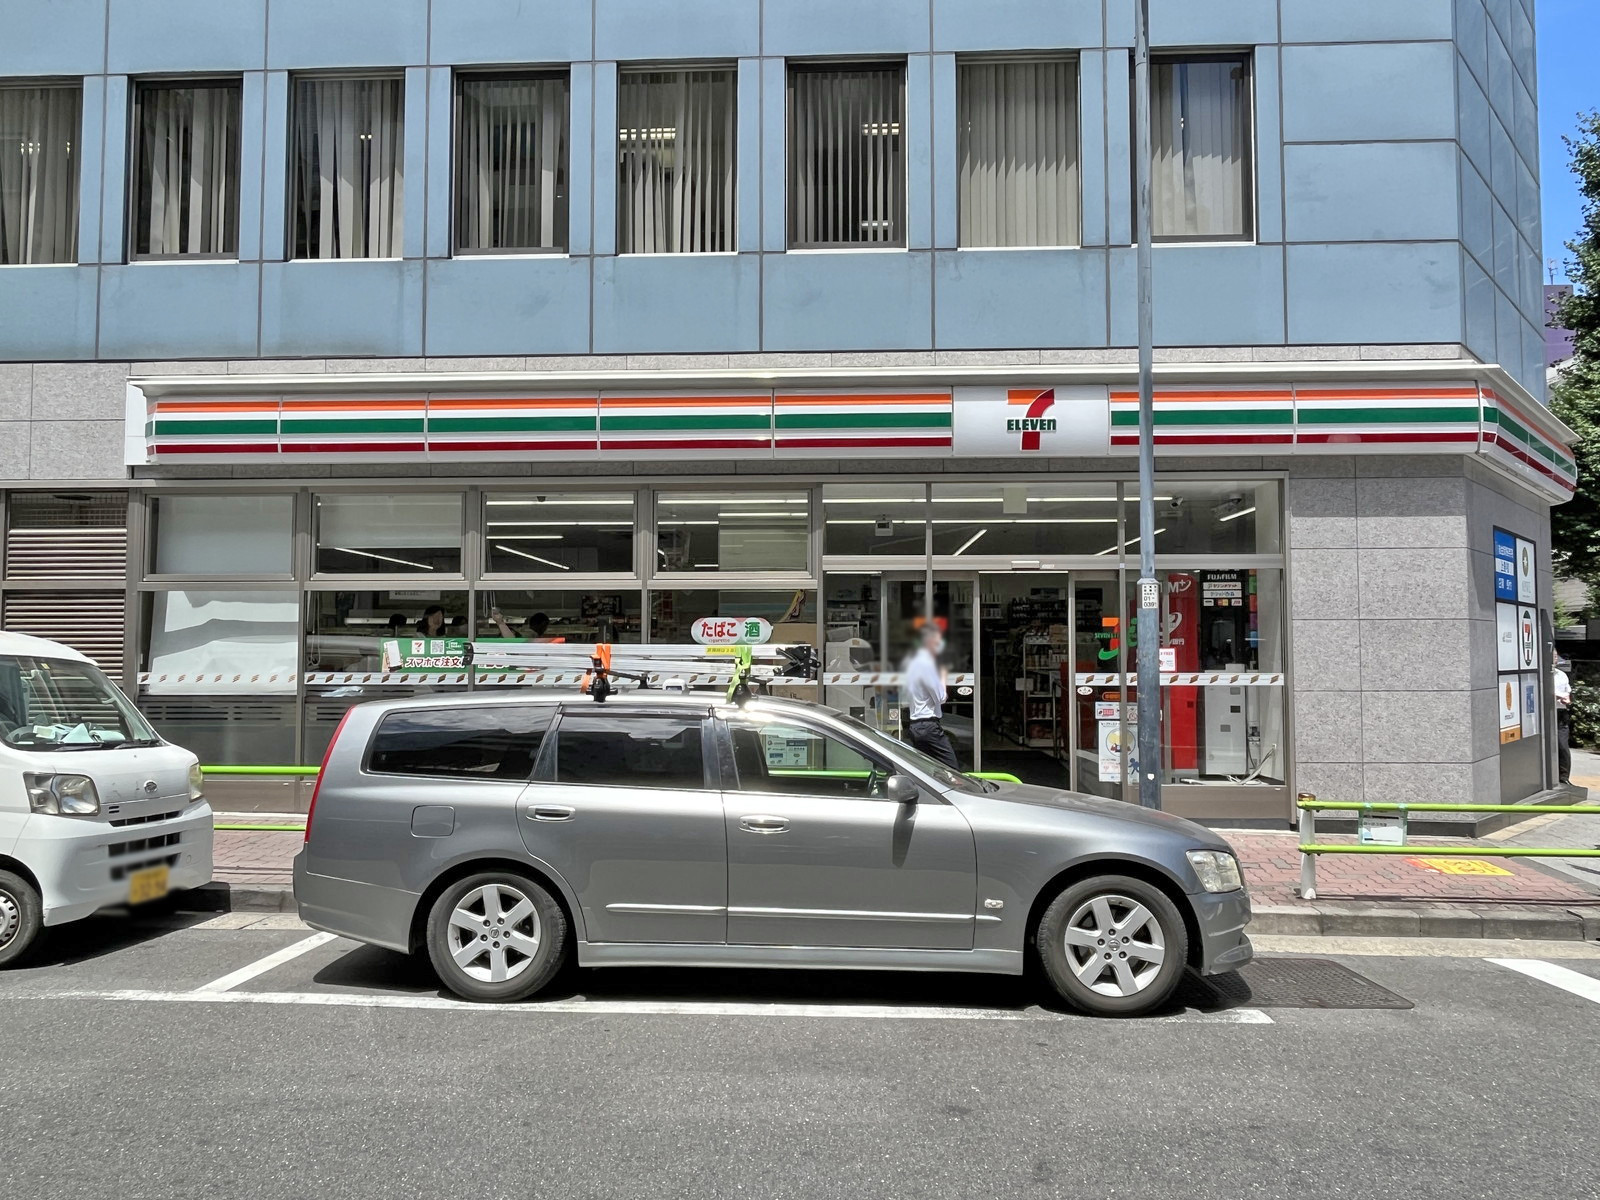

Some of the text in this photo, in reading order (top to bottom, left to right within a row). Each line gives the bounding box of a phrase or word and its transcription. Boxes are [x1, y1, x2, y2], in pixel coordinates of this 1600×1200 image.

[701, 621, 761, 637] たばこ 酒
